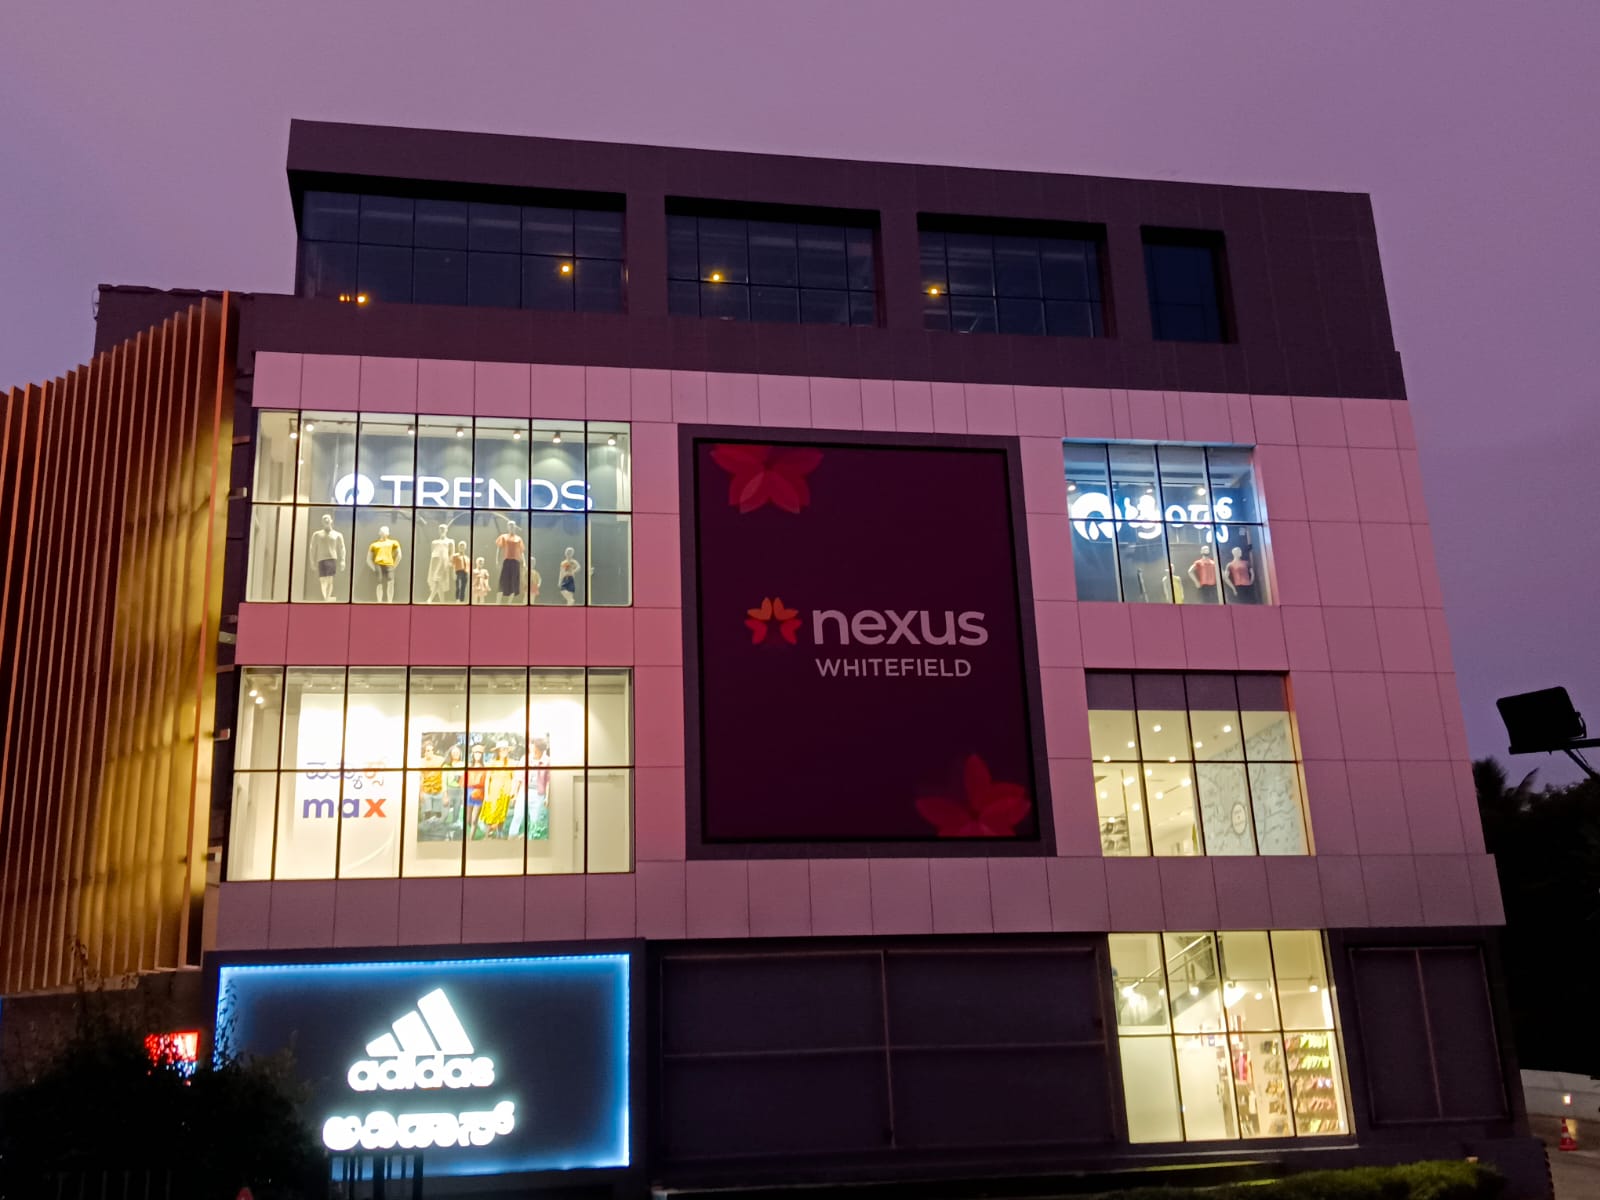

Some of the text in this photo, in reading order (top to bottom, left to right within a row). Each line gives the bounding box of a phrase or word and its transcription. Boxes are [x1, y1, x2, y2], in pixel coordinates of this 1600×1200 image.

[380, 475, 593, 511] TRENDS
[812, 609, 989, 647] nexus
[815, 658, 972, 677] WHITEFIELD
[302, 798, 387, 819] max
[348, 1051, 495, 1091] adidas
